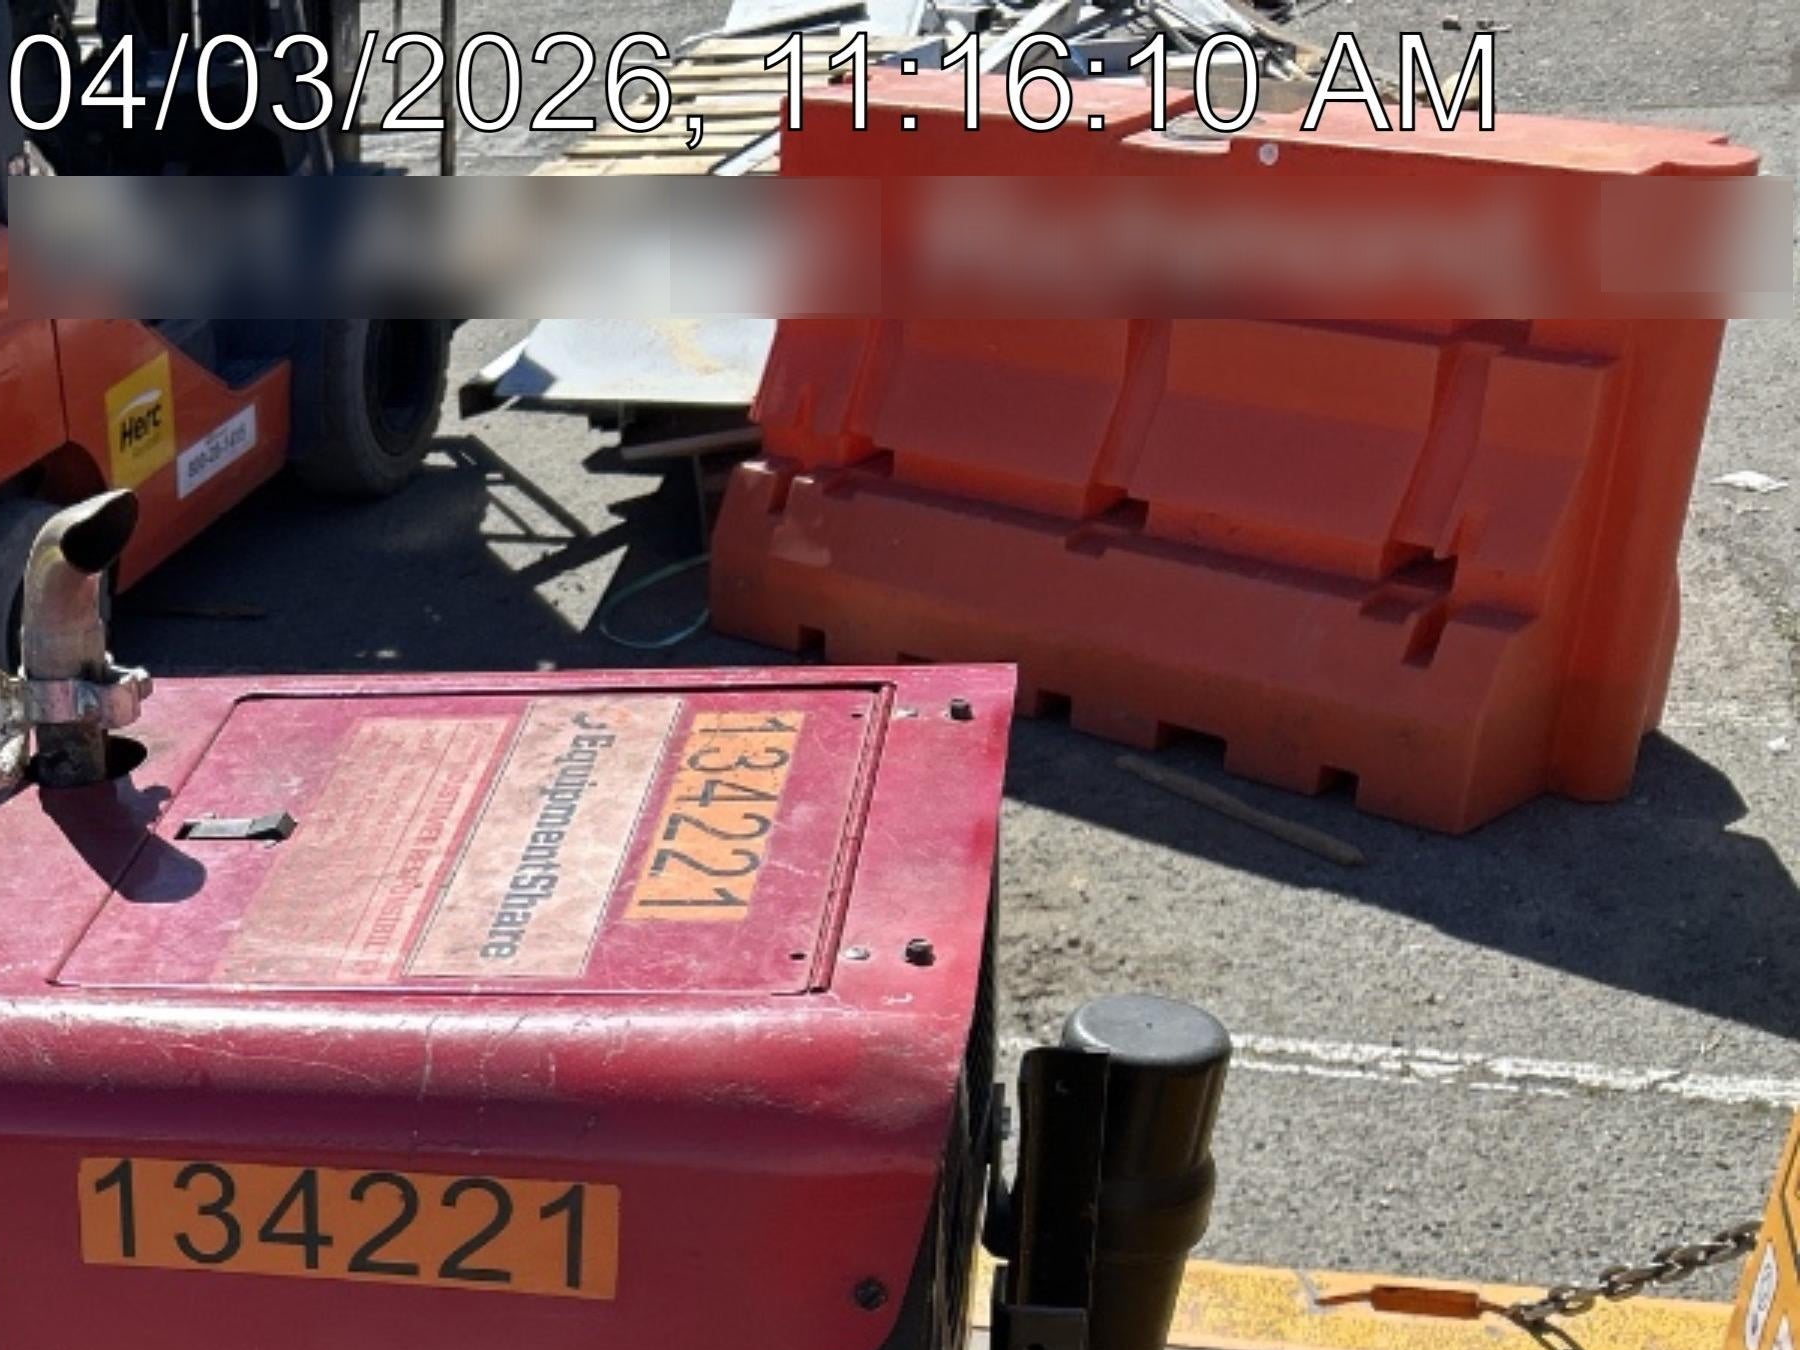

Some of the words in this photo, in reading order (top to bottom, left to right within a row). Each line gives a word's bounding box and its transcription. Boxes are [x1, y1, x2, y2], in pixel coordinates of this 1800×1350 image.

[119, 403, 162, 453] Herc
[480, 733, 616, 960] EquipmentShare
[638, 715, 798, 909] 134221
[94, 1158, 585, 1289] 134221
